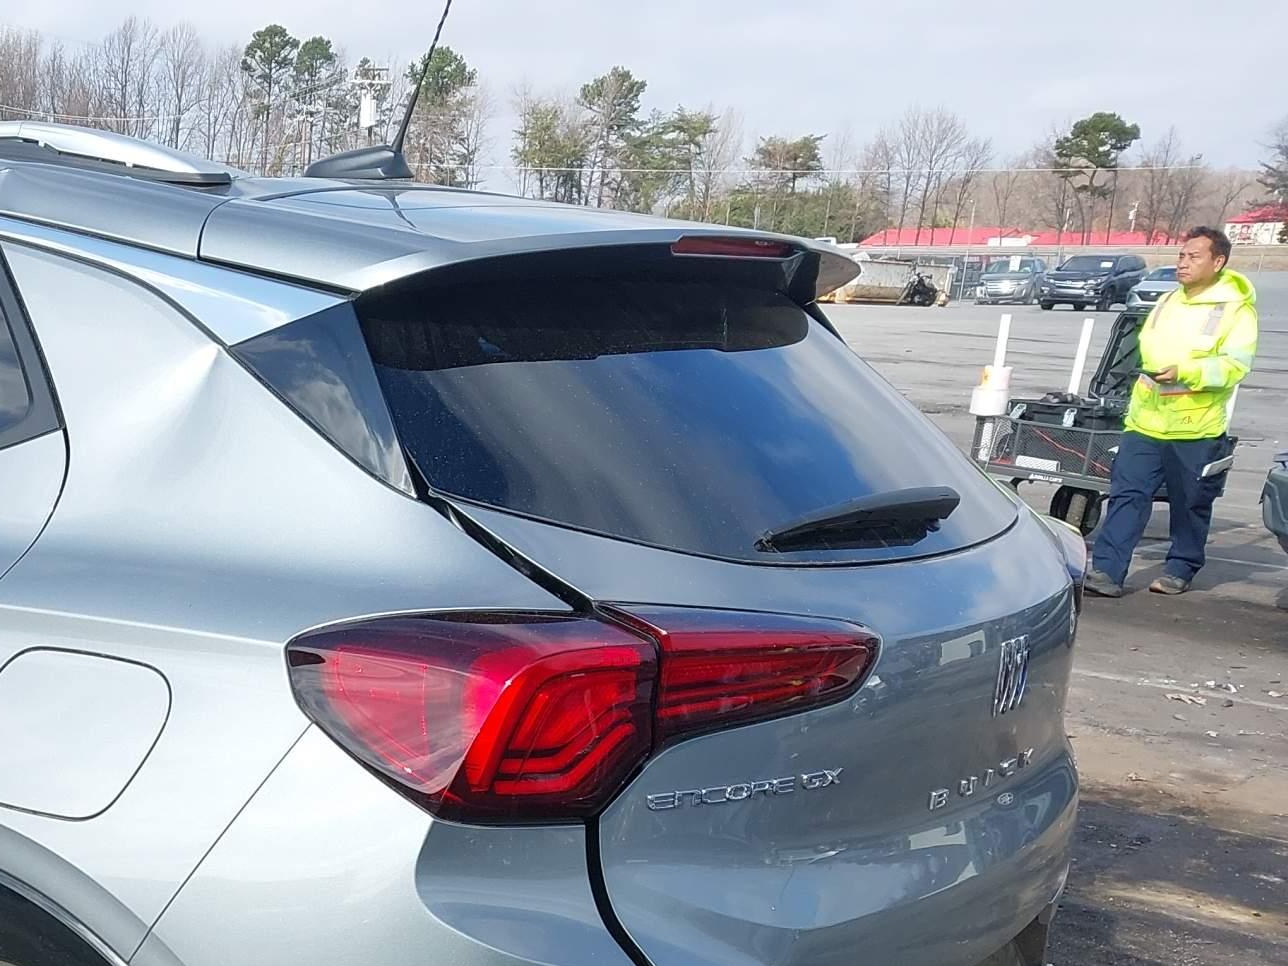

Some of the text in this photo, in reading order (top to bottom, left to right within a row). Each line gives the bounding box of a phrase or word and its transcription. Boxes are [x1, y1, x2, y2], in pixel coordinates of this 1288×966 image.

[646, 767, 844, 811] ENCORE GX
[928, 747, 1034, 811] BUICK
